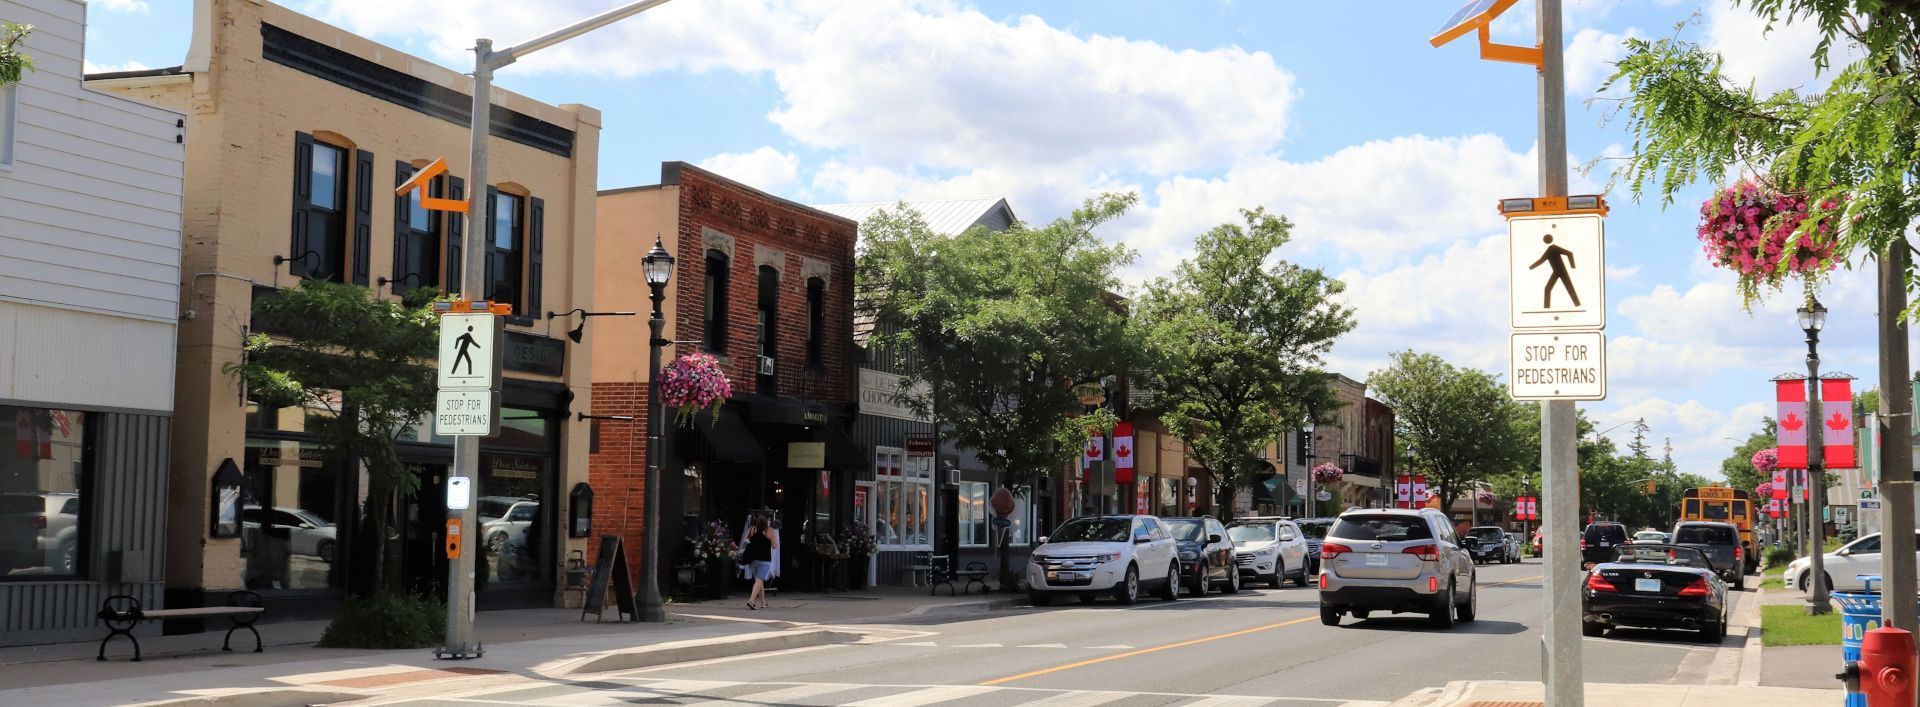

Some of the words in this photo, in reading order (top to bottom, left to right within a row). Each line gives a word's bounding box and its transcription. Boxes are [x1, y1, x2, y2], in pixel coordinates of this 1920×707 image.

[1525, 345, 1555, 361] STOP
[1565, 345, 1588, 361] FOR
[1517, 367, 1596, 385] PEDESTRIANS
[446, 399, 463, 411] STOP
[467, 399, 481, 411] FOR
[439, 414, 487, 426] PEDESTRIANS
